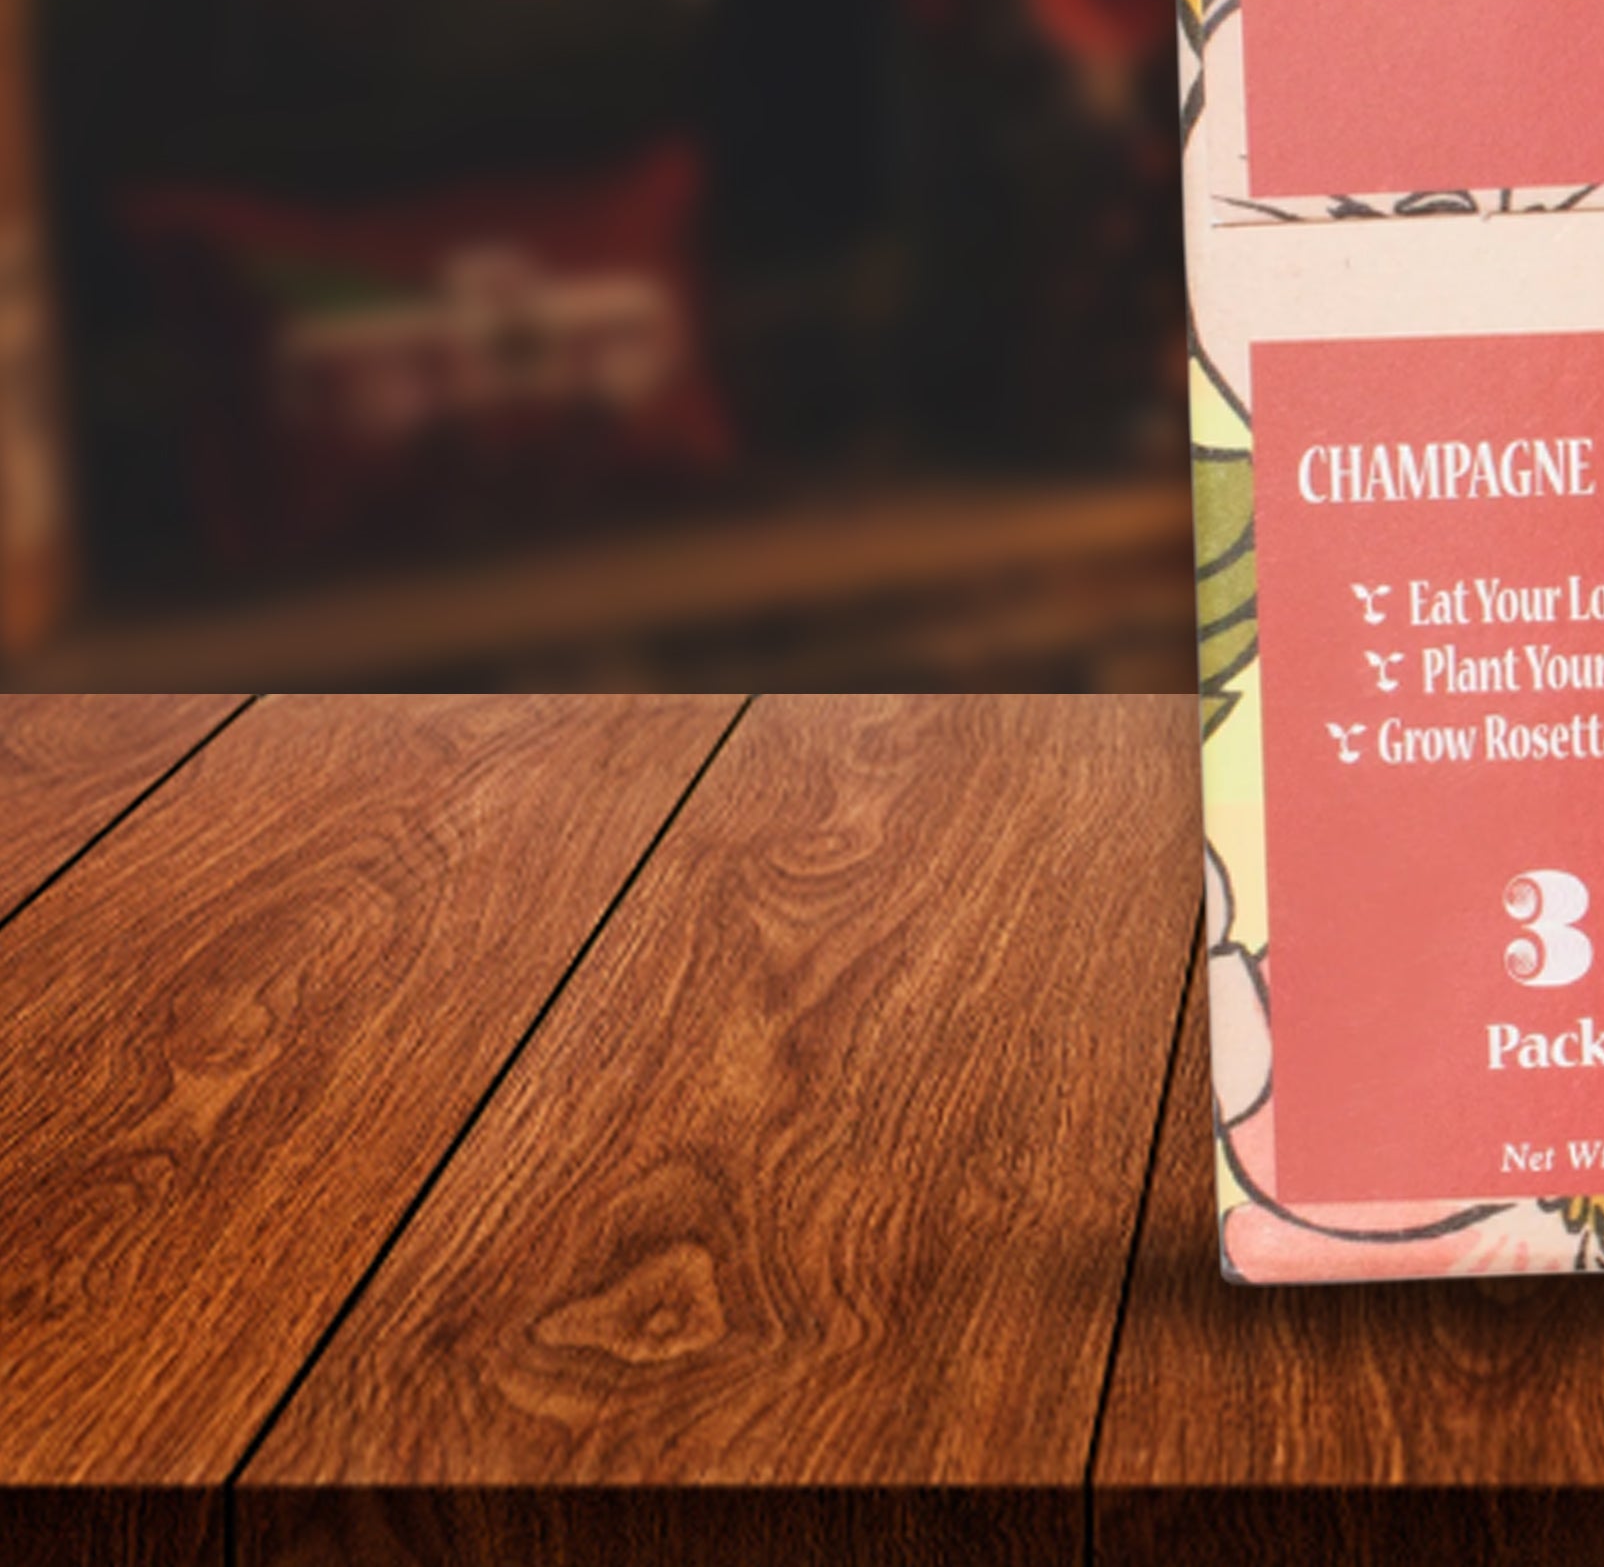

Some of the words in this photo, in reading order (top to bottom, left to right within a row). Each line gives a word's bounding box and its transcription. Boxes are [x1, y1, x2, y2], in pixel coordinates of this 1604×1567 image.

[1297, 437, 1596, 504] CHAMPAGNE
[1409, 580, 1472, 626] Eat
[1474, 576, 1562, 623] Your
[1422, 644, 1520, 694] Plant
[1377, 717, 1477, 765] Grow
[1503, 869, 1594, 988] 3
[1500, 1141, 1556, 1174] Net
